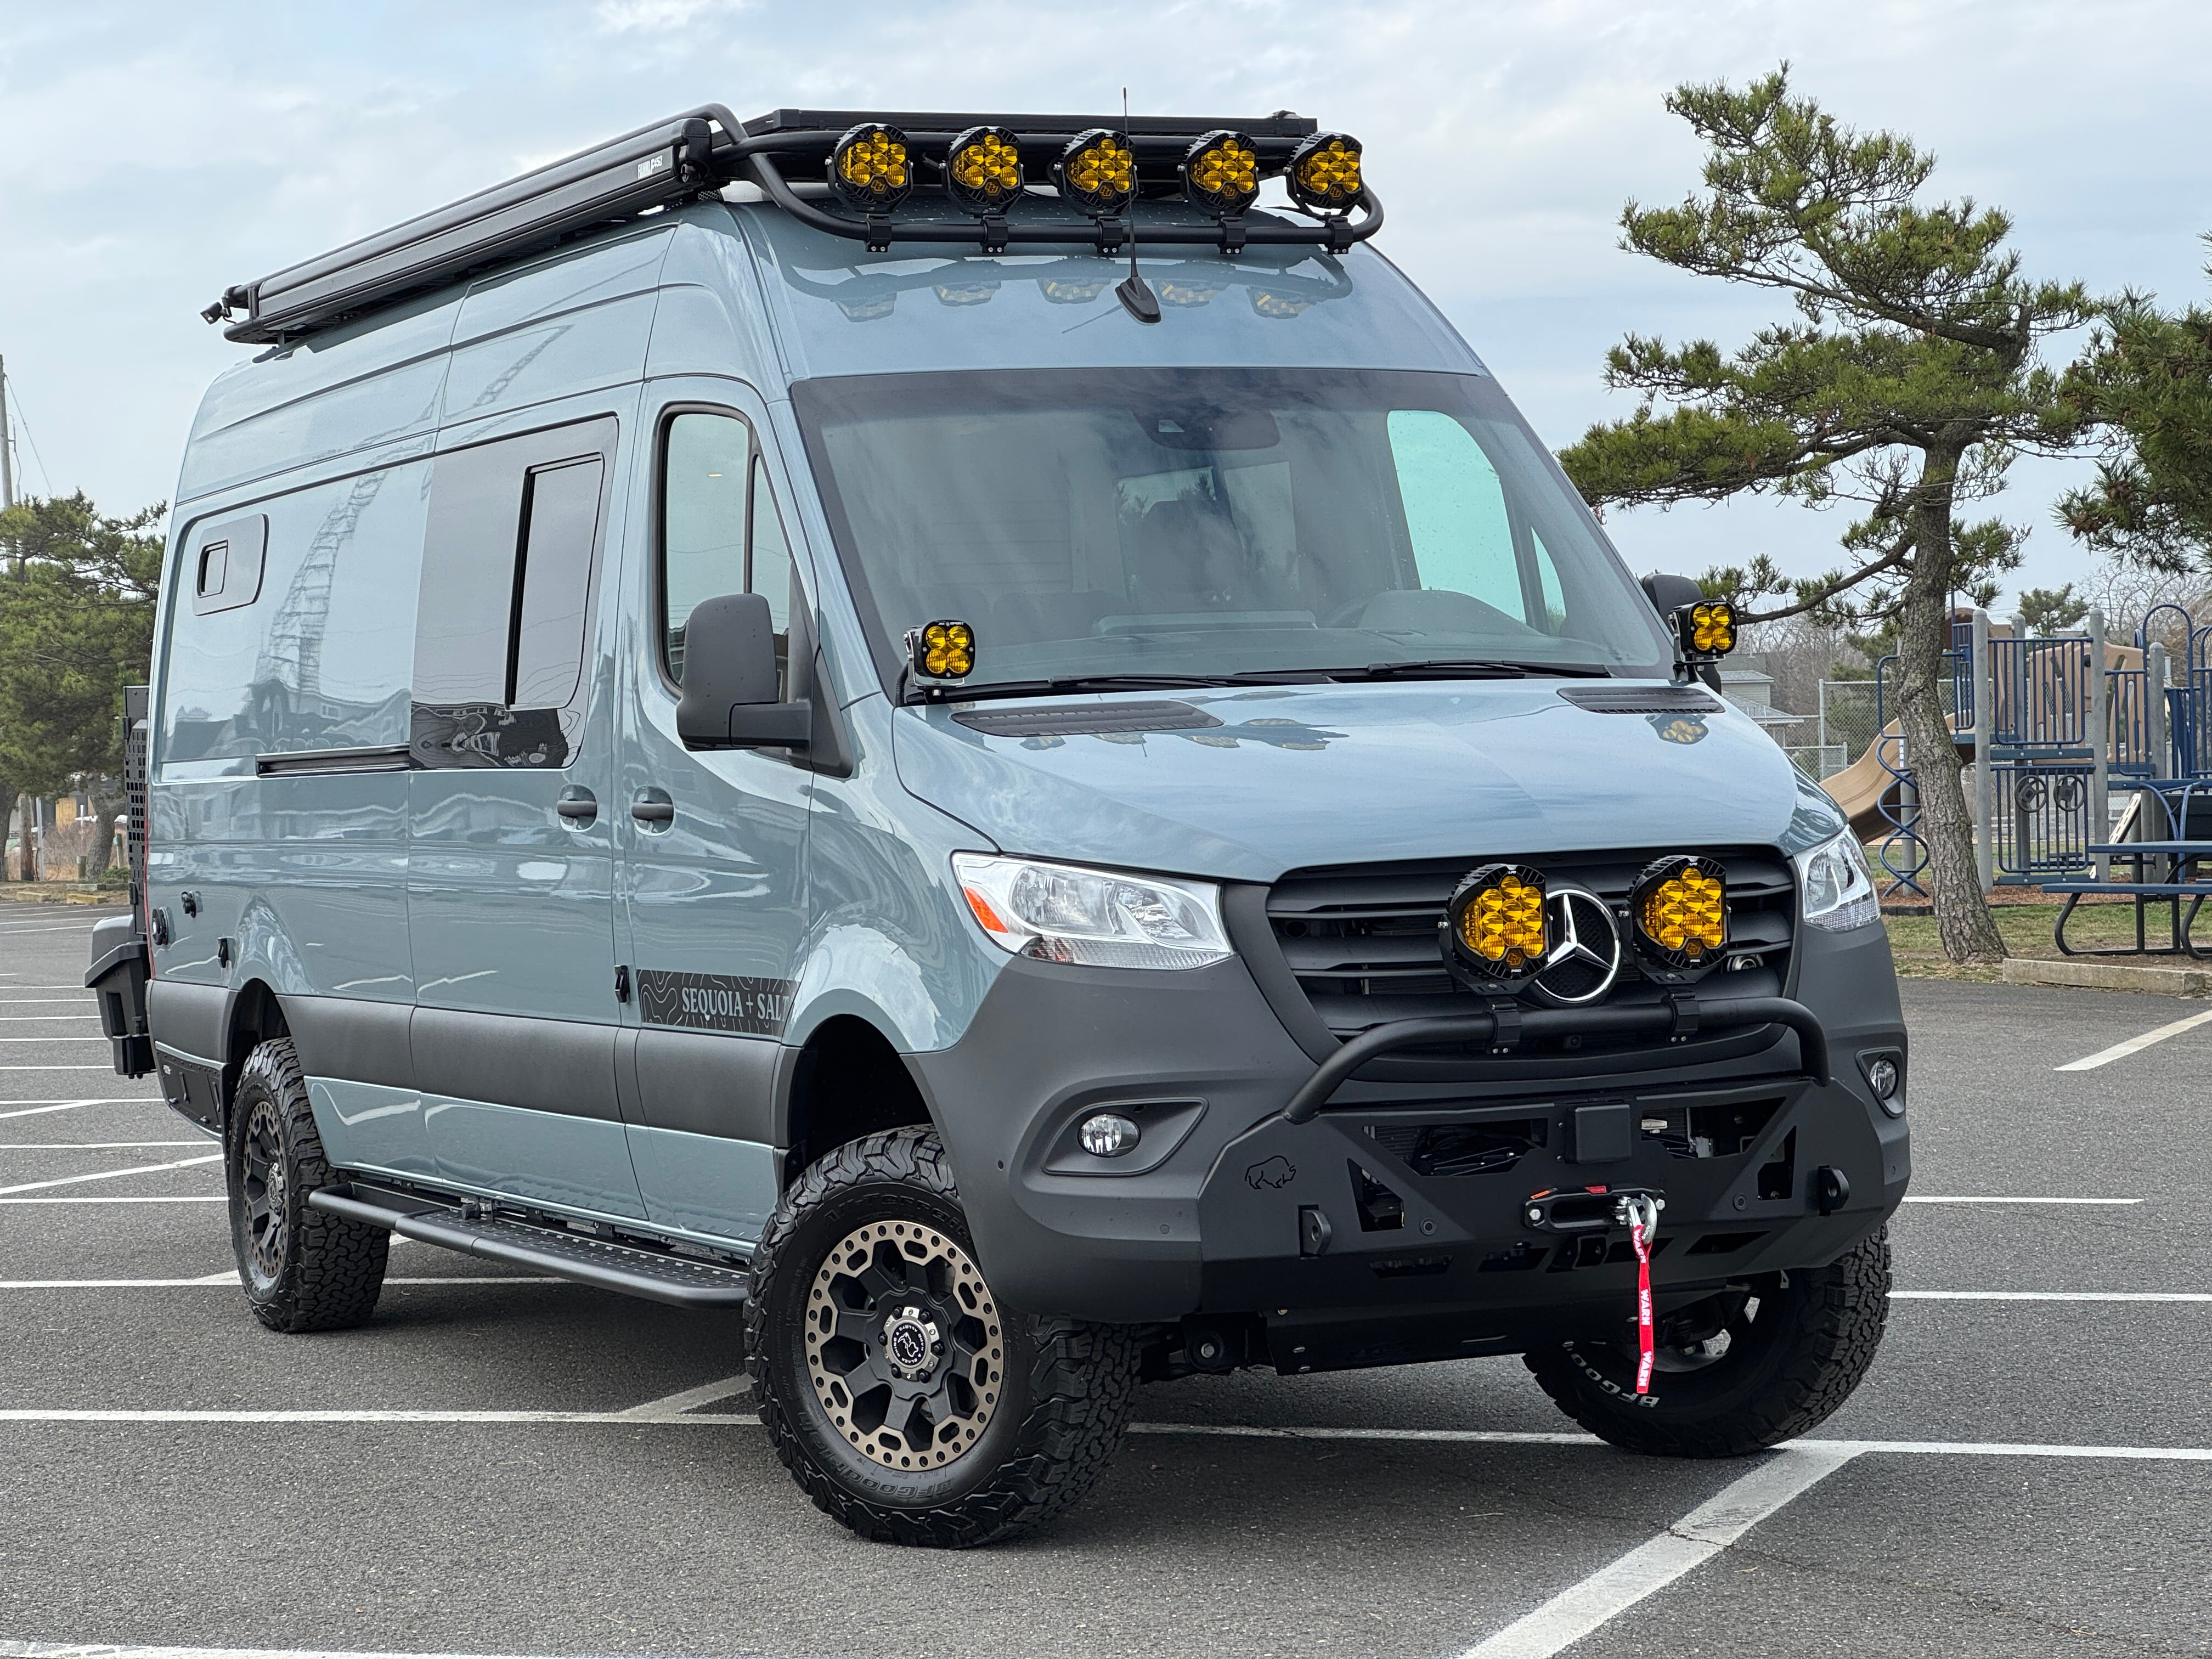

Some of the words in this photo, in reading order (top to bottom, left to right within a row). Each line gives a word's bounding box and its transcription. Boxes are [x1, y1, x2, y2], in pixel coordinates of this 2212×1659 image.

[682, 987, 744, 1020] SEQUOIA
[757, 993, 790, 1022] SALT
[1633, 1228, 1647, 1263] WARN
[1640, 1289, 1651, 1325] WARN
[1638, 1351, 1652, 1386] WARN
